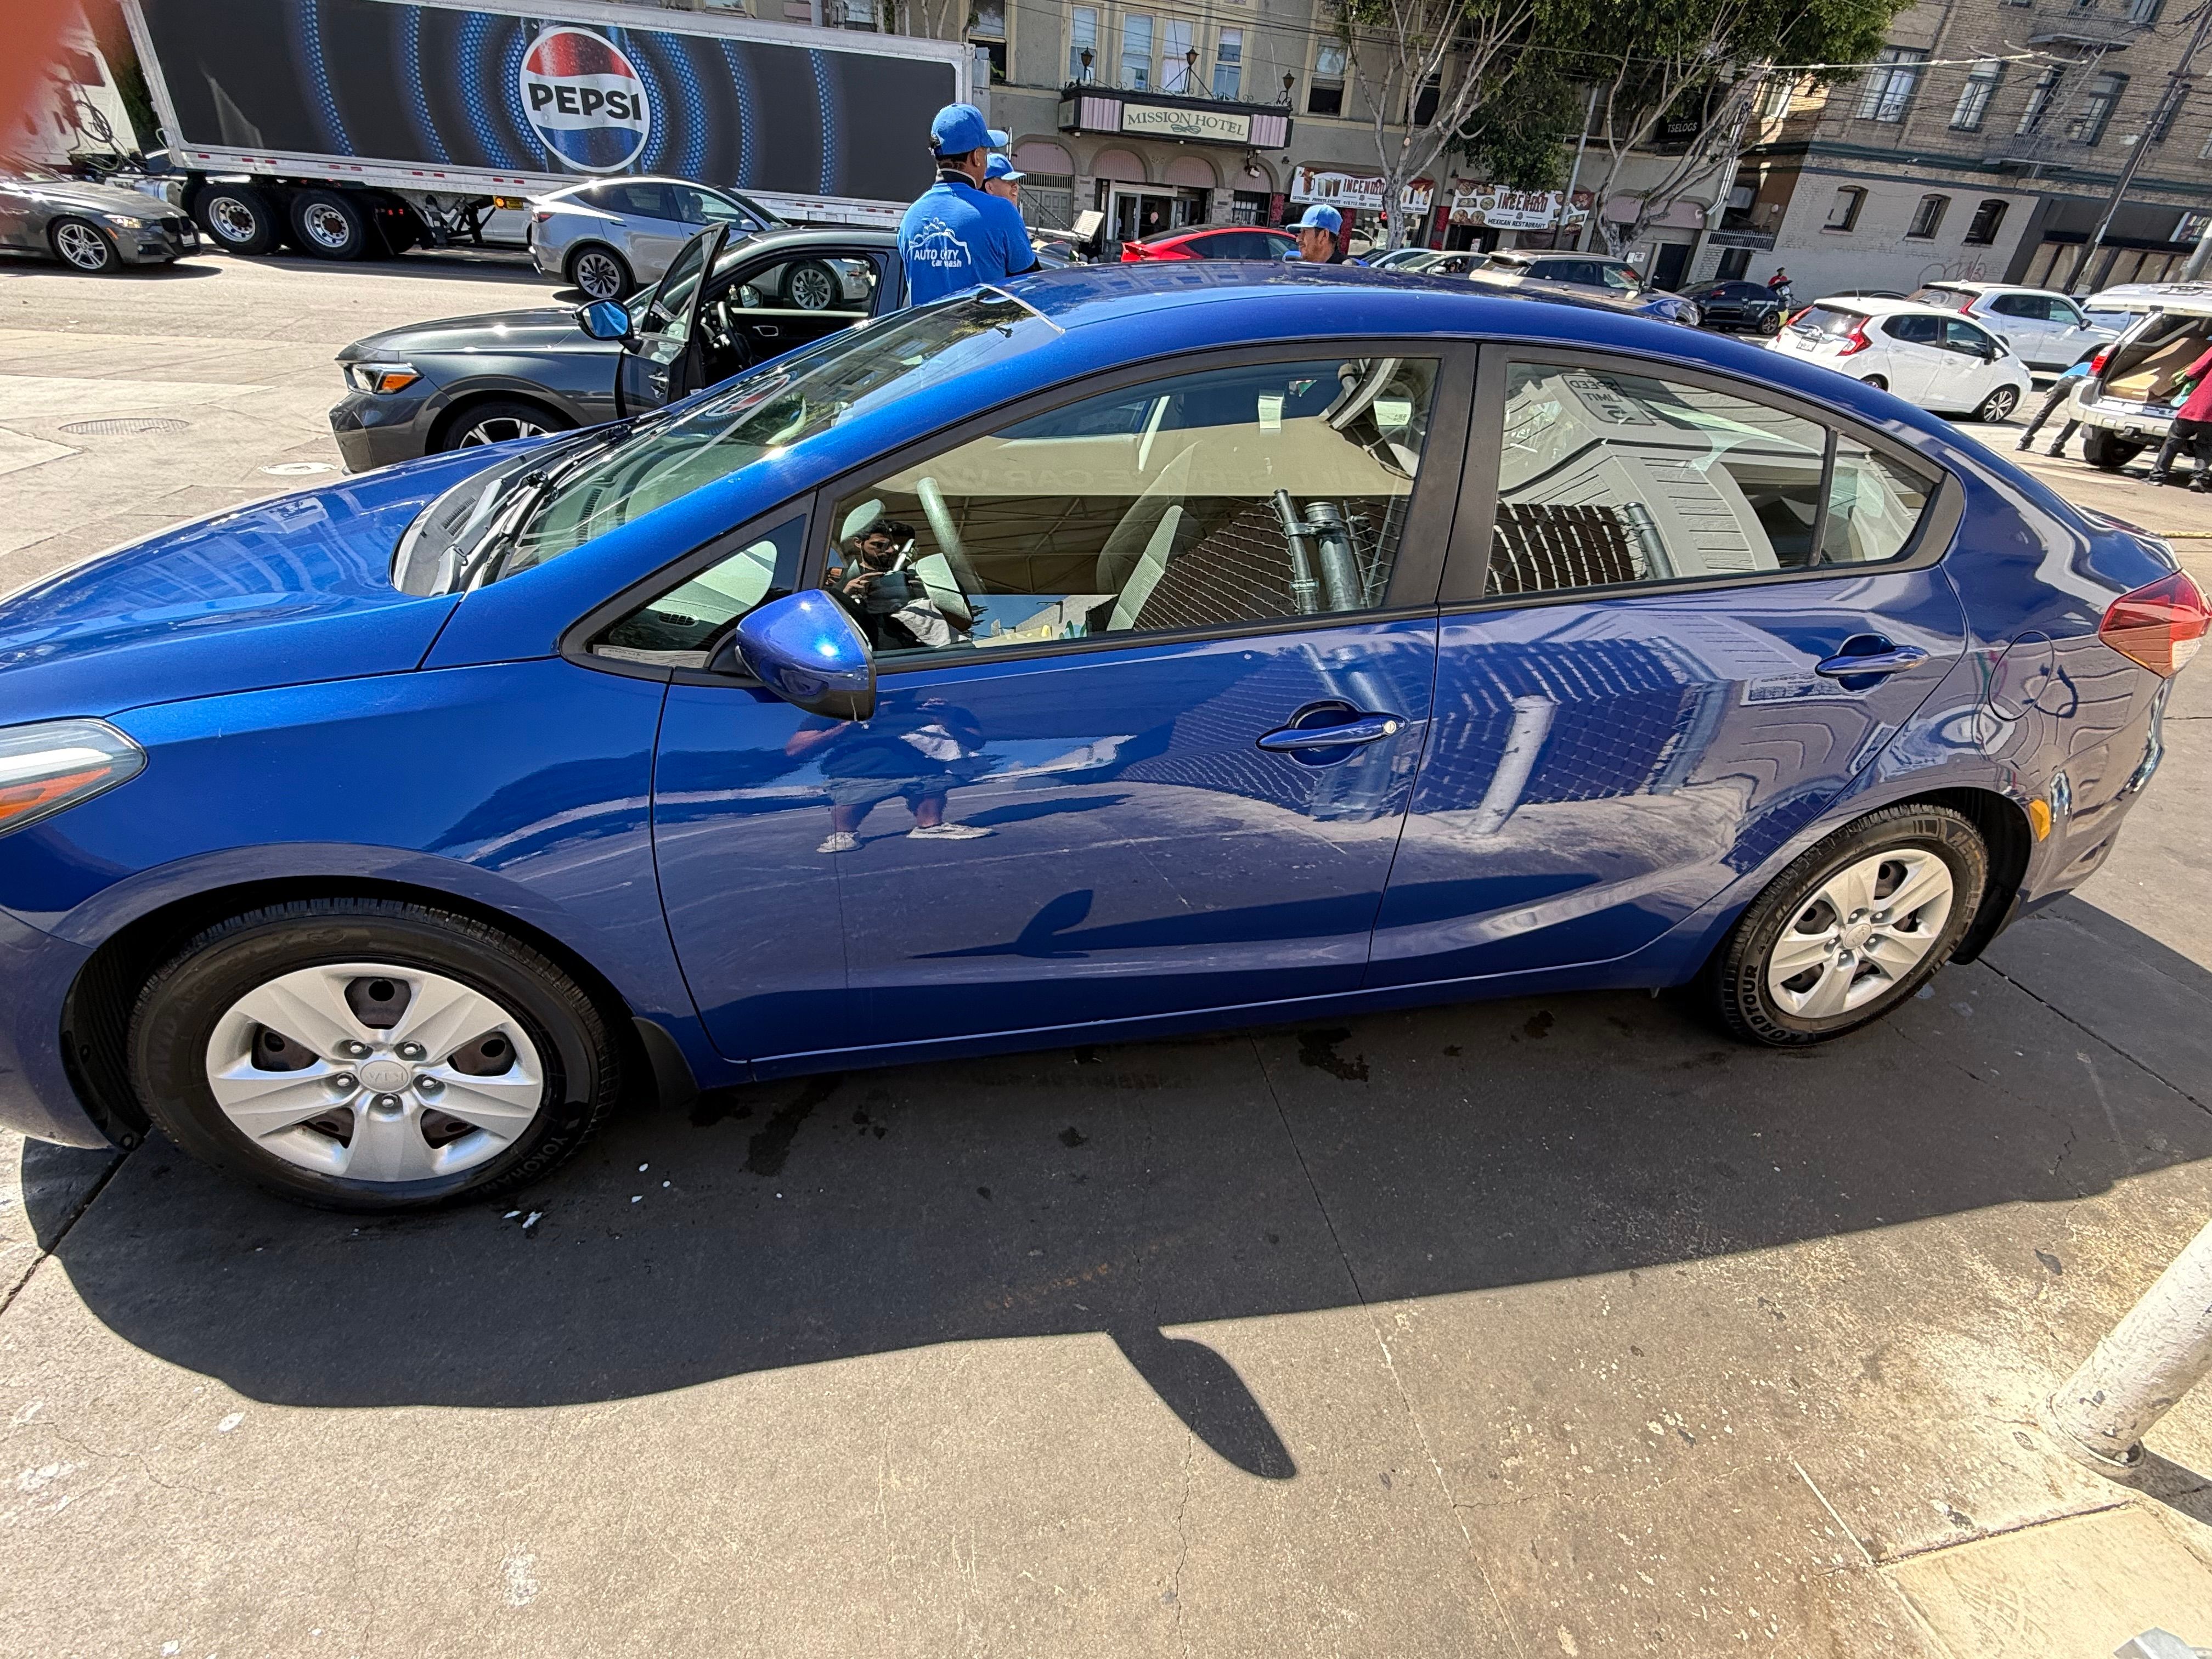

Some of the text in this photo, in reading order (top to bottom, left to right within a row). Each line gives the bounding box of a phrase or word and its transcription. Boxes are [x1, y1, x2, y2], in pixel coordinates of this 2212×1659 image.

[528, 82, 642, 121] PEPSI
[1127, 112, 1244, 136] MISSION HOTEL
[1667, 122, 1697, 133] TSELOGS
[1488, 218, 1546, 229] MEXICAN RESTAURANT
[914, 249, 959, 261] AUTO CITY
[944, 259, 962, 268] wash
[1742, 964, 1804, 1045] ROADTOUR
